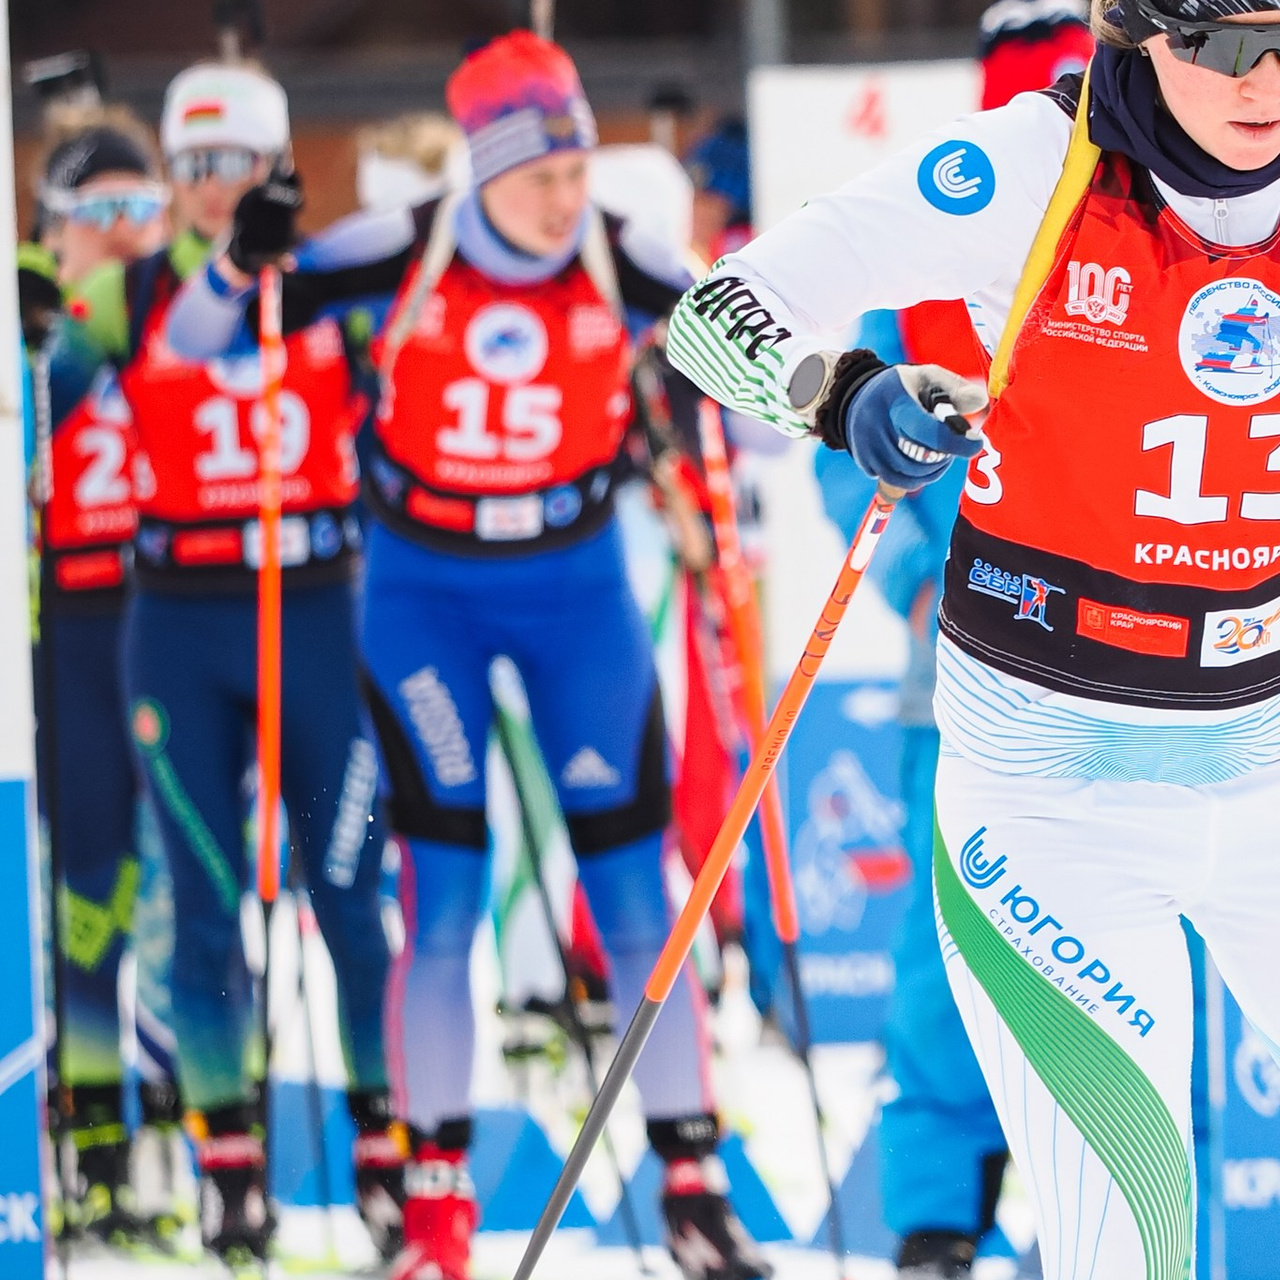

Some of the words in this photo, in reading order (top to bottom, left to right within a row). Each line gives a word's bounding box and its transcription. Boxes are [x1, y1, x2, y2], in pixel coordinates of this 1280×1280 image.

[1188, 281, 1250, 316] ПЕРВЕНСТВО
[1041, 326, 1095, 343] РОССИЙСКОЙ
[1095, 337, 1149, 352] ФЕДЕРАЦИИ
[1047, 320, 1112, 337] МИНИСТЕРСТВО
[1113, 330, 1146, 343] СПОРТА
[193, 392, 311, 482] 19
[436, 377, 563, 462] 15
[969, 566, 1021, 596] СБР
[1110, 611, 1183, 631] КРАСНОЯРСКИЙ
[1110, 619, 1135, 631] КРАЙ
[761, 729, 789, 772] PREMIO
[988, 908, 1100, 1015] СТРАХОВАНИЕ
[1000, 884, 1156, 1038] ЮГОРИЯ
